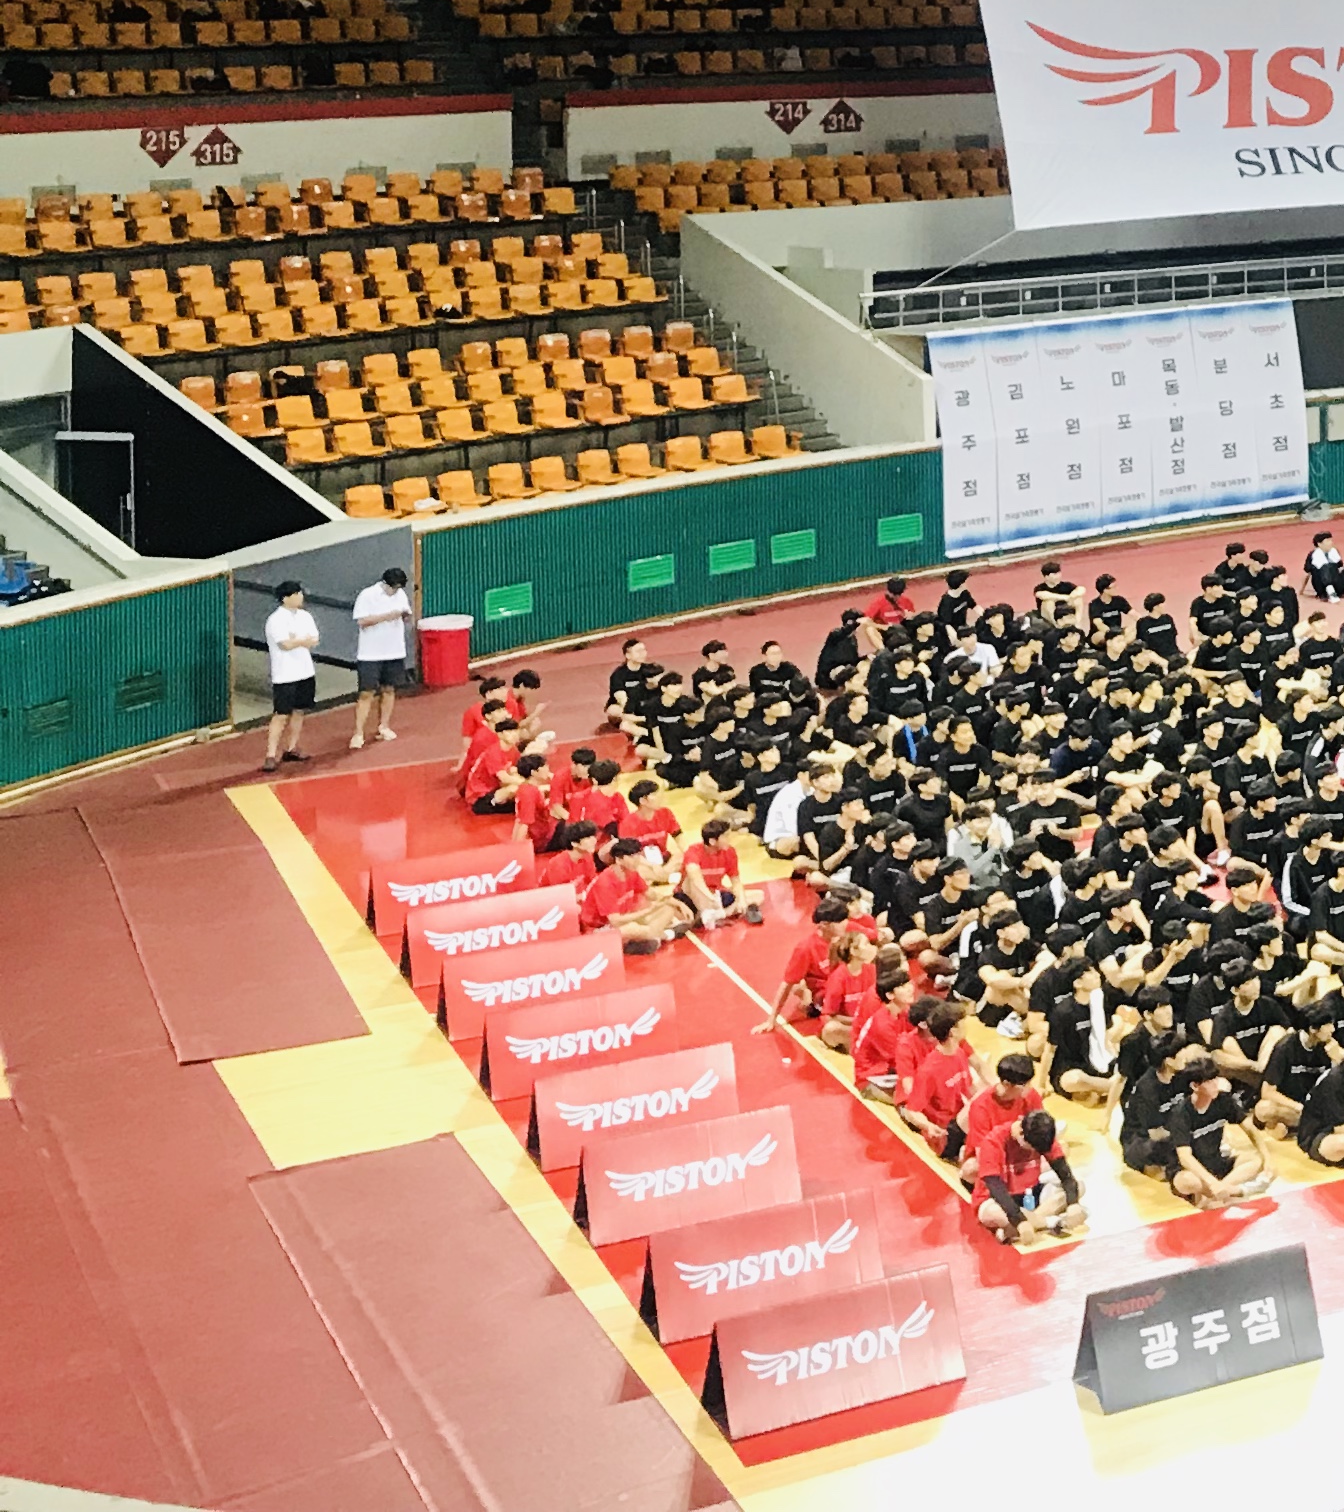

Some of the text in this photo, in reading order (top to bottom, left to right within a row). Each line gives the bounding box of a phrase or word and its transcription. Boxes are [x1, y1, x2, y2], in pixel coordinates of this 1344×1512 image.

[774, 103, 804, 121] 214
[828, 113, 856, 131] 314
[146, 130, 180, 152] 215
[199, 142, 235, 164] 315
[1060, 375, 1083, 480] 노원점
[1111, 370, 1133, 474] 마포점
[1213, 358, 1237, 460] 분당점
[1264, 352, 1289, 452] 서초점
[955, 389, 978, 498] 광주점
[1007, 383, 1032, 491] 김포점
[406, 871, 501, 906] PISTON
[444, 918, 543, 955] PISTON
[481, 966, 585, 1006] PISTON
[526, 1021, 636, 1064] PISTON
[578, 1085, 694, 1131] PISTON
[630, 1150, 751, 1201] PISTON
[701, 1238, 830, 1294] PISTON
[771, 1320, 905, 1385] PISTON
[1139, 1296, 1281, 1371] 광주점
